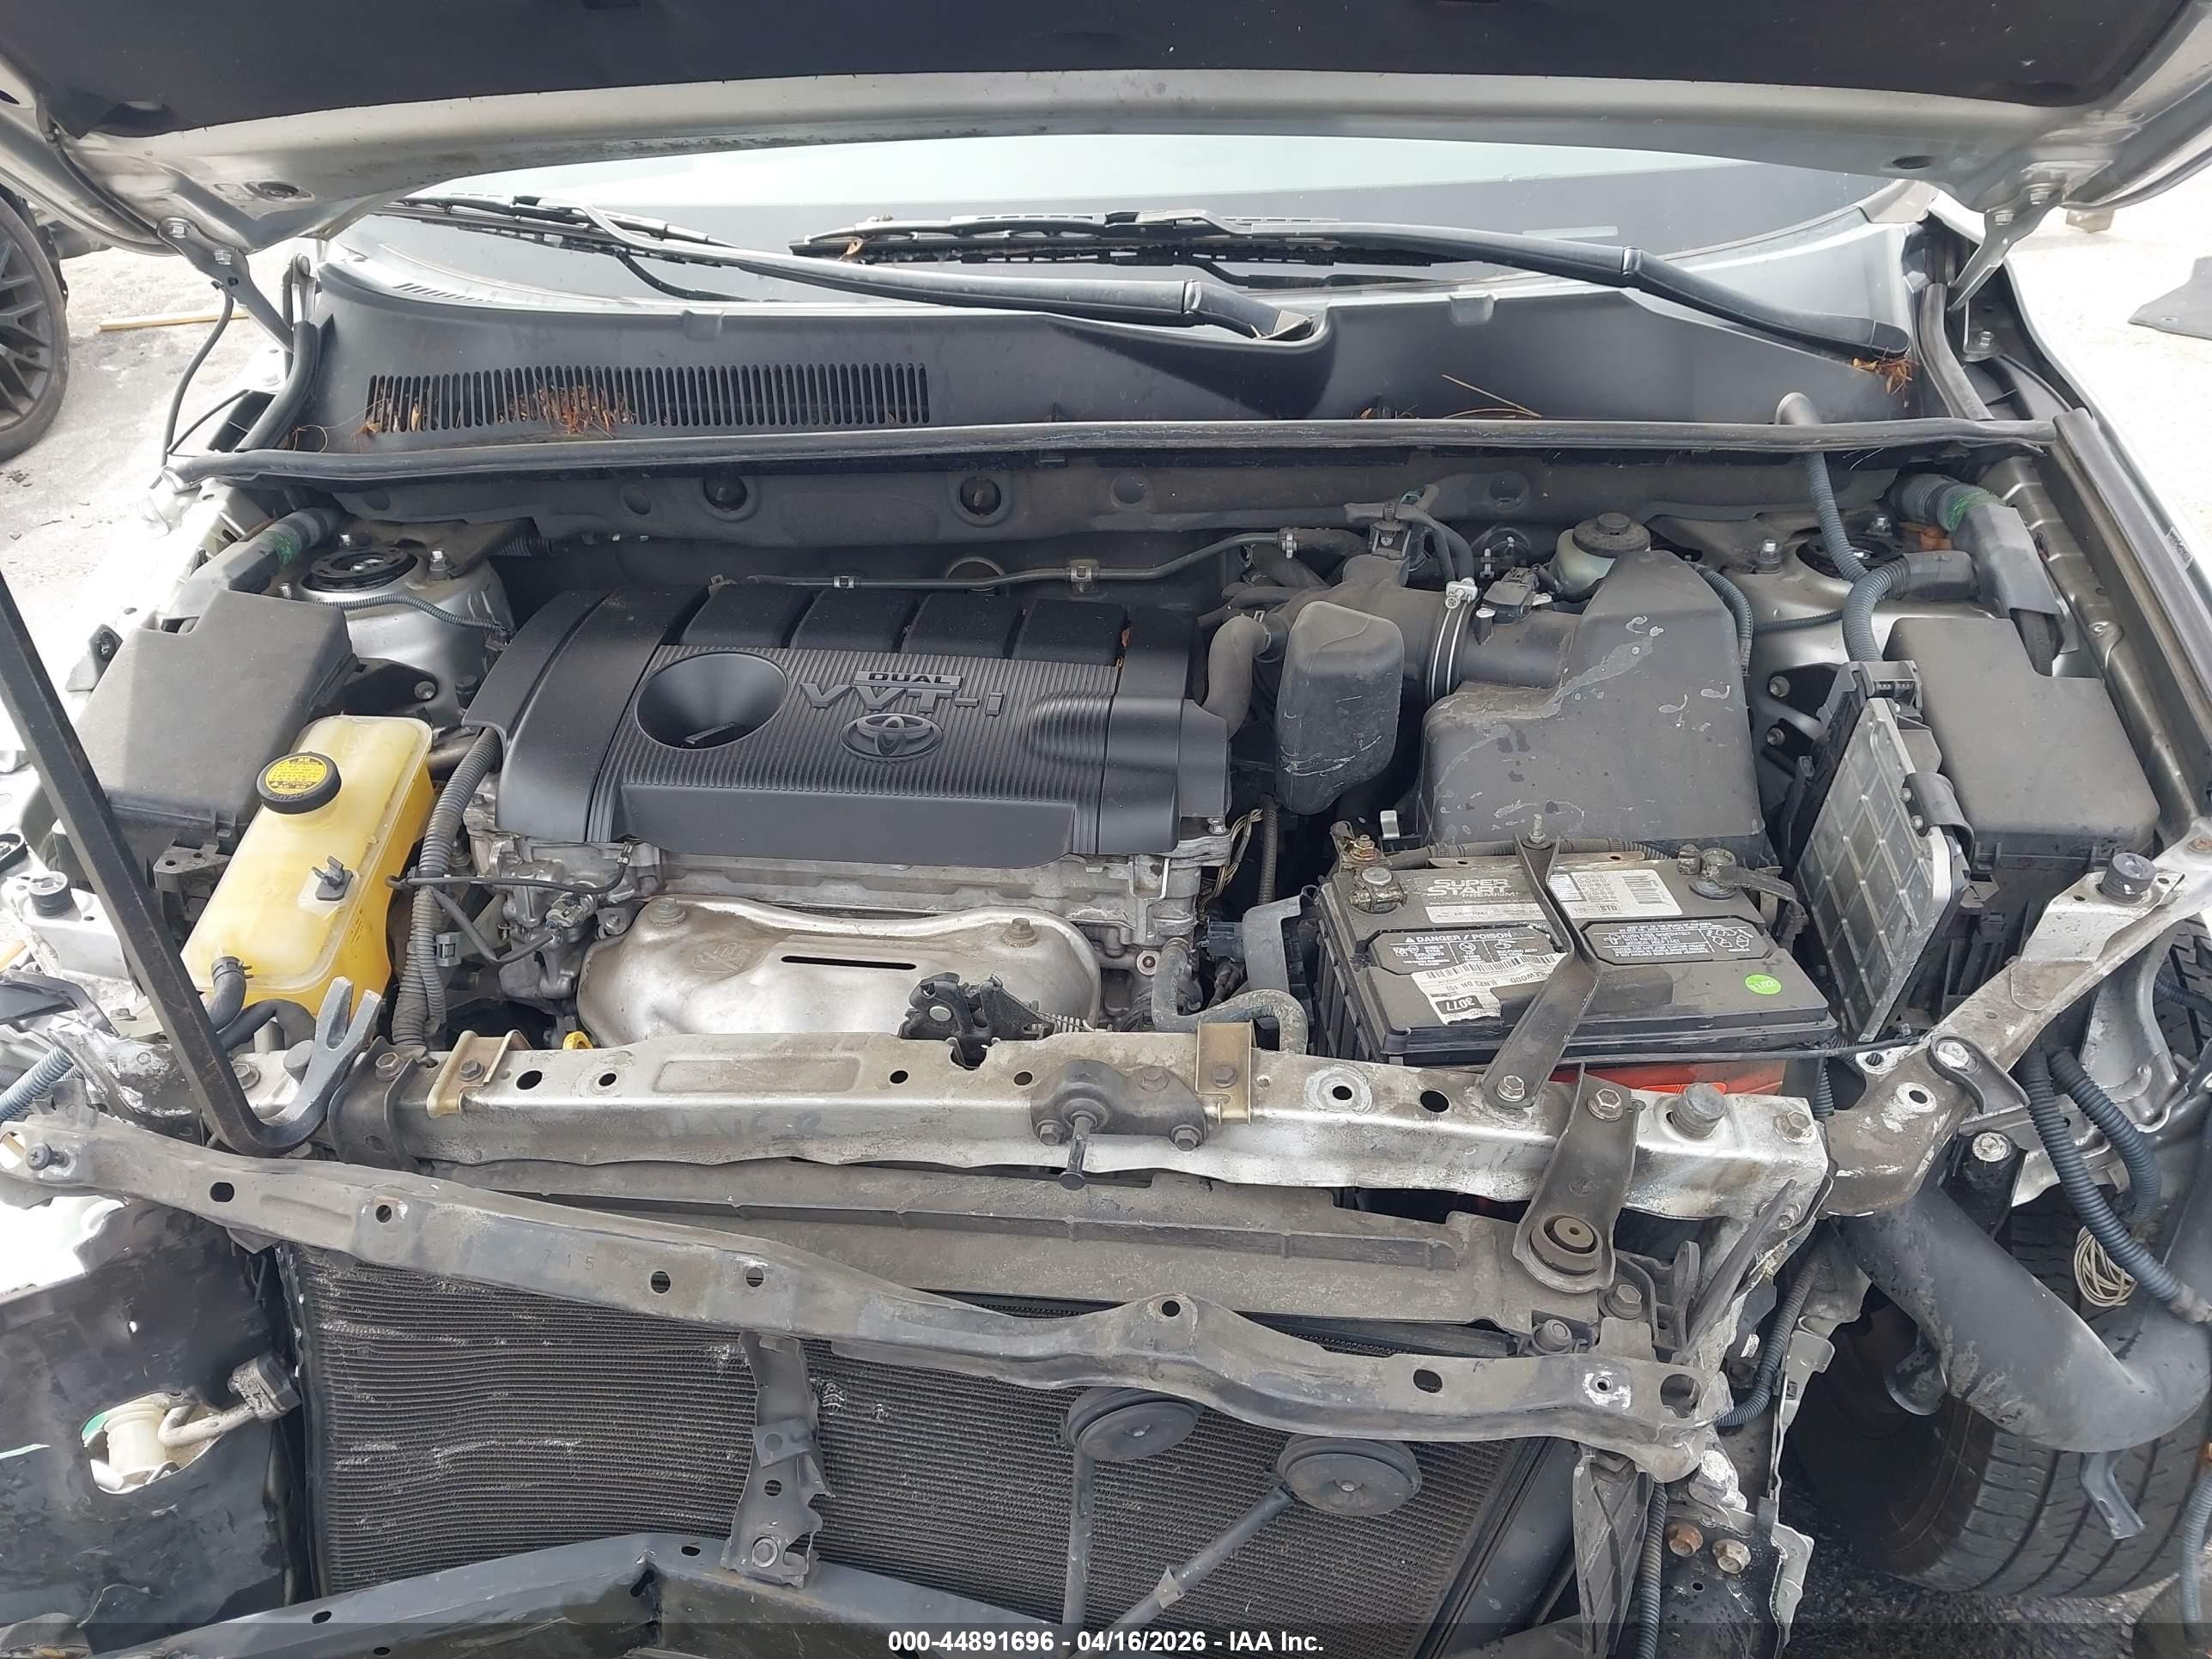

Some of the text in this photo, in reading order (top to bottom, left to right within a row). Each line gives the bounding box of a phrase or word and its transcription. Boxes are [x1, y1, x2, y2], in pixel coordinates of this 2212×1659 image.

[868, 672, 951, 684] DUAL
[800, 682, 1005, 716] VVT-i
[1433, 878, 1510, 887] SUPER
[1427, 885, 1511, 896] START
[1416, 934, 1461, 943] DANGER
[1471, 931, 1513, 940] POISON
[1446, 997, 1475, 1012] 3077
